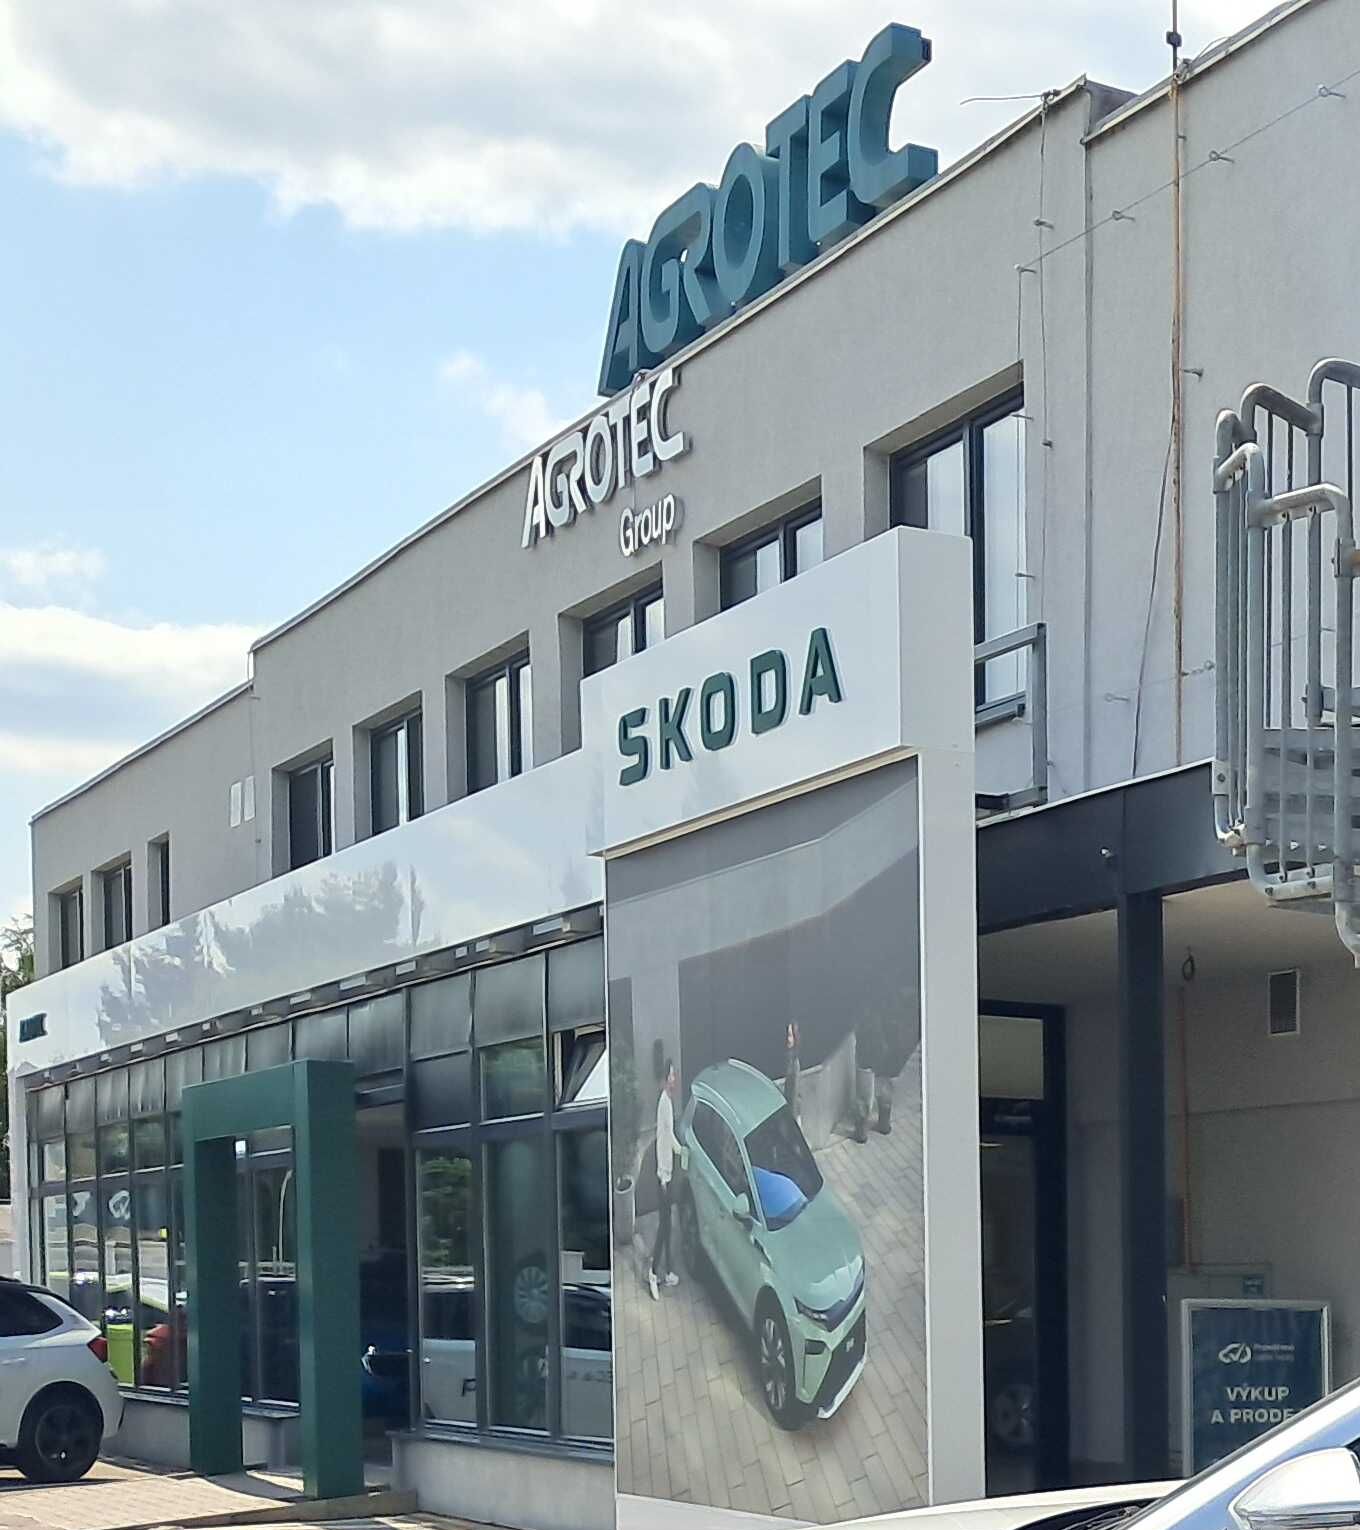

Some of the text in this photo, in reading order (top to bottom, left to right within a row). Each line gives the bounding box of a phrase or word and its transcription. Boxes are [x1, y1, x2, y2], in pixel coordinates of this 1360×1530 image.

[598, 22, 939, 397] AGROTEC
[521, 368, 687, 548] AGROTEC
[619, 493, 675, 557] Group
[618, 627, 843, 786] SKODA
[1211, 1407, 1299, 1424] A PRODE
[1226, 1383, 1290, 1402] VÝKUP
